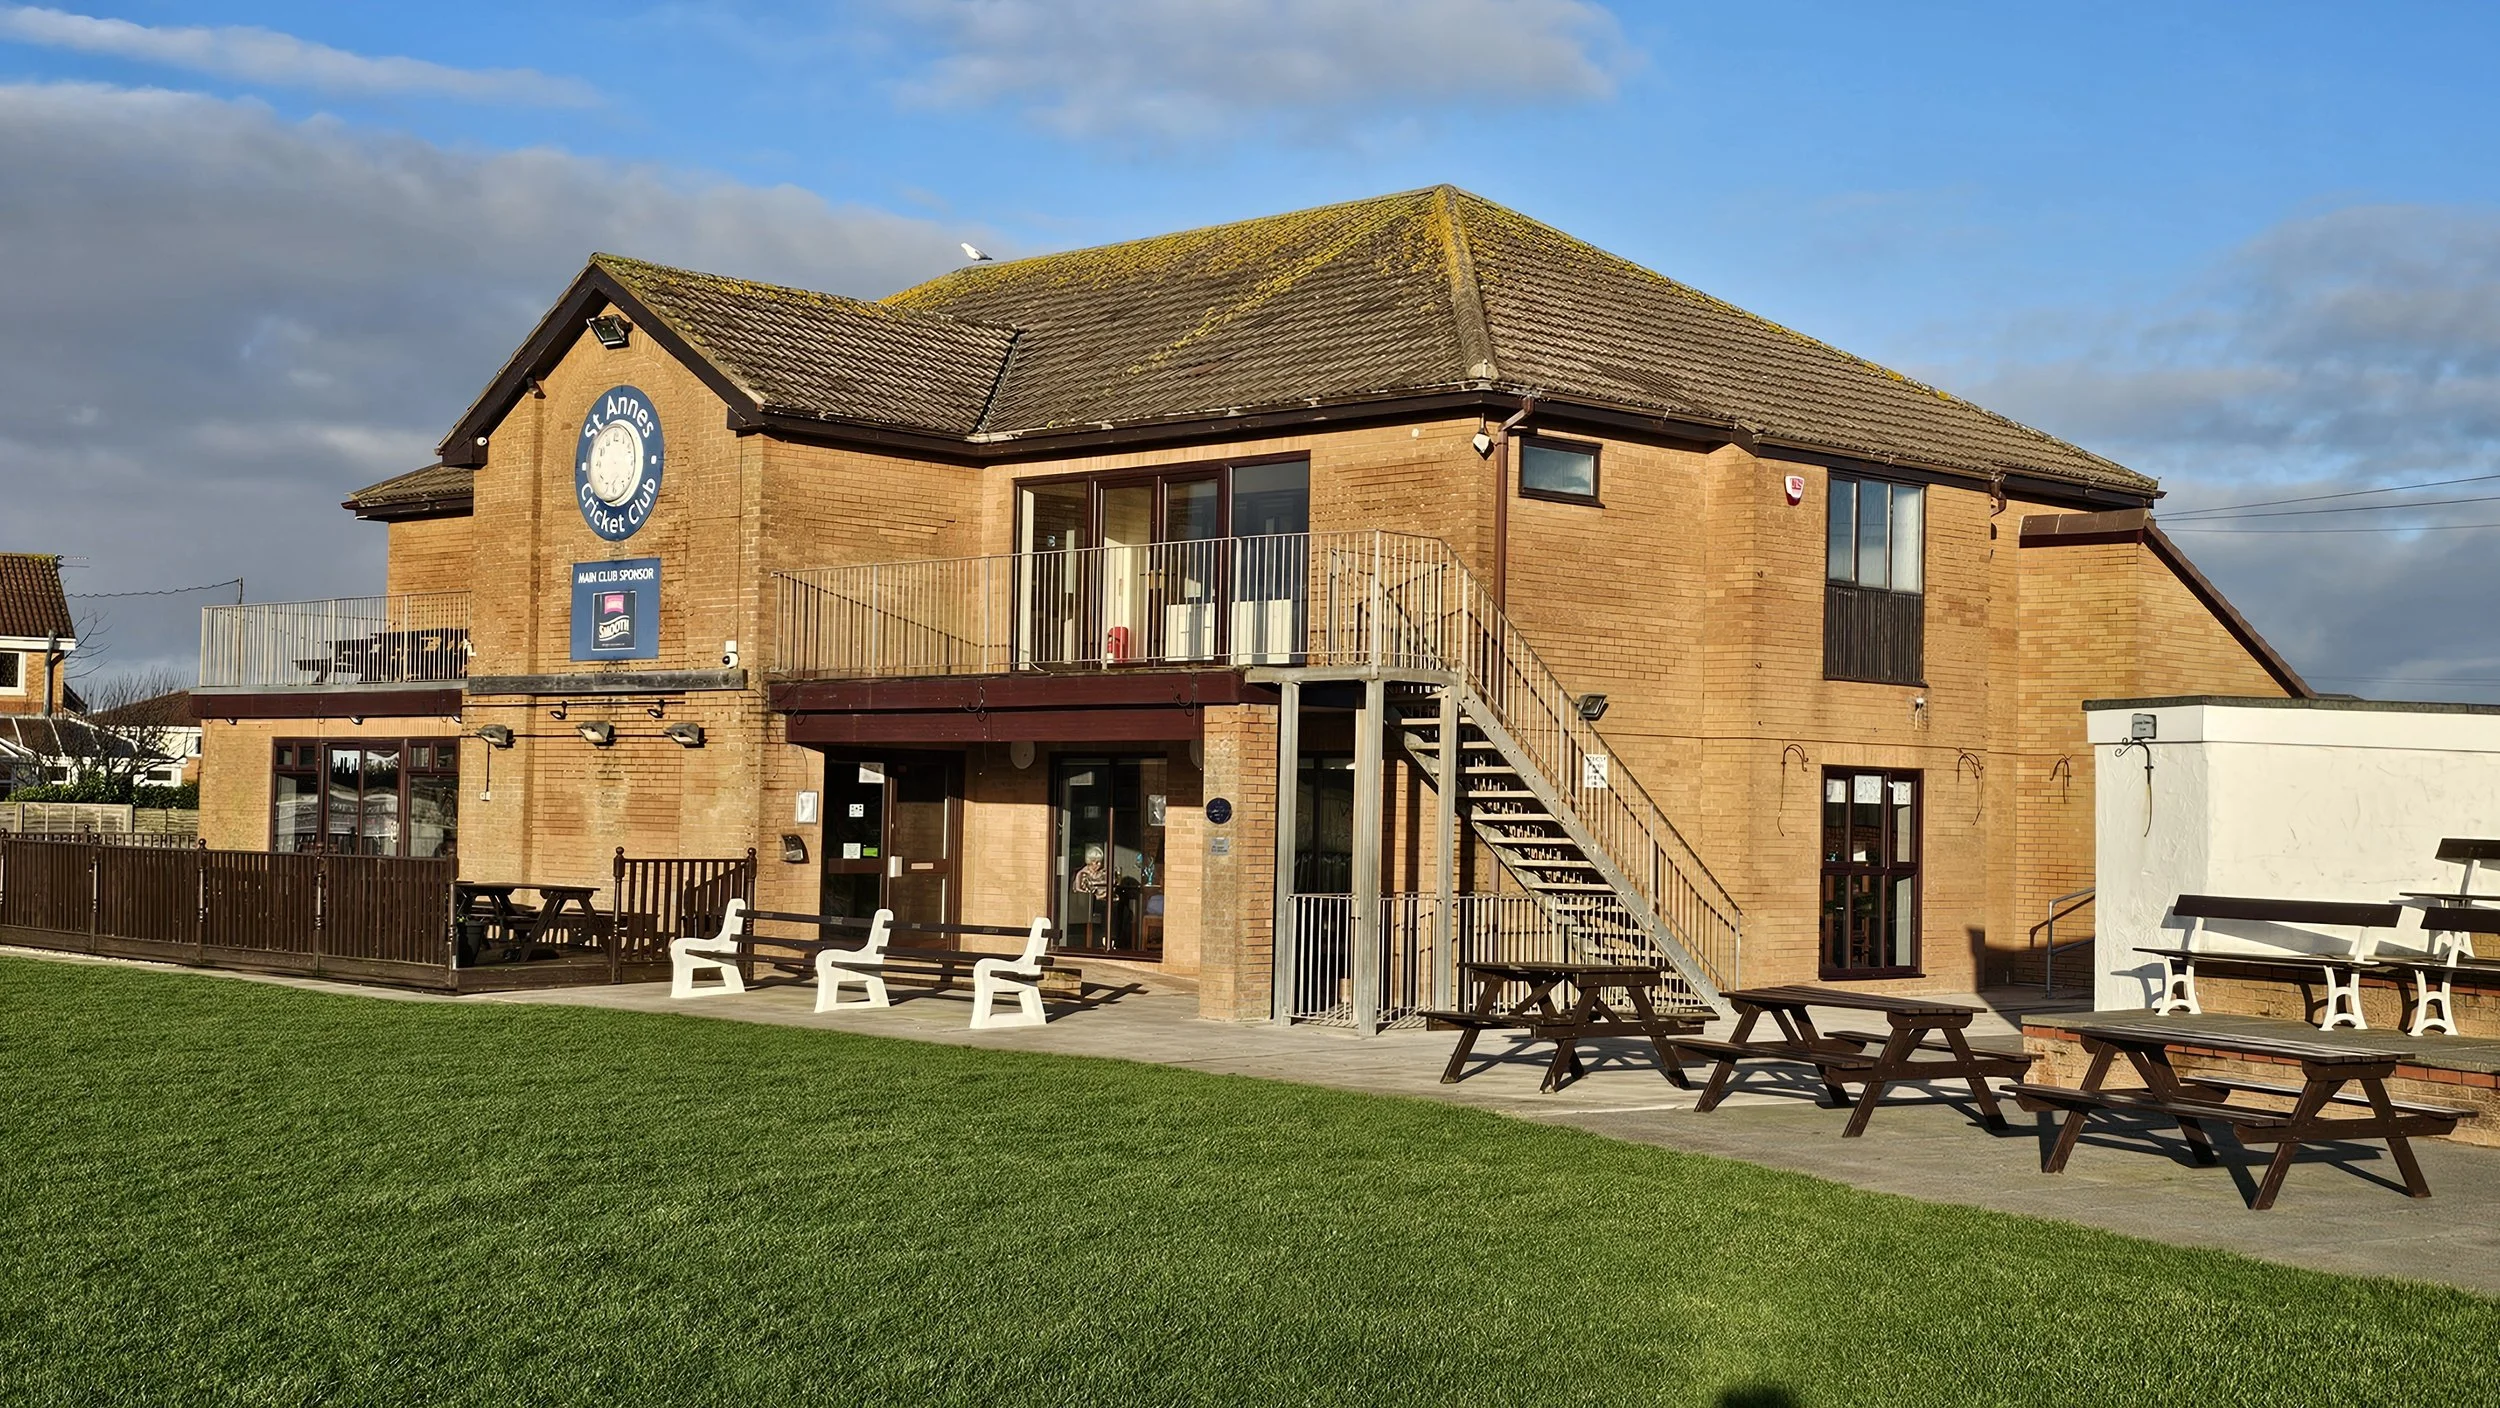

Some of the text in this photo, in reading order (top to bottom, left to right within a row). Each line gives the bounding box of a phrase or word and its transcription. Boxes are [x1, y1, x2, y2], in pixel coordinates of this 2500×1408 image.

[585, 395, 654, 440] St Annes
[581, 477, 656, 534] Cricket Club
[578, 568, 654, 583] MAIN CLUB SPONSOR
